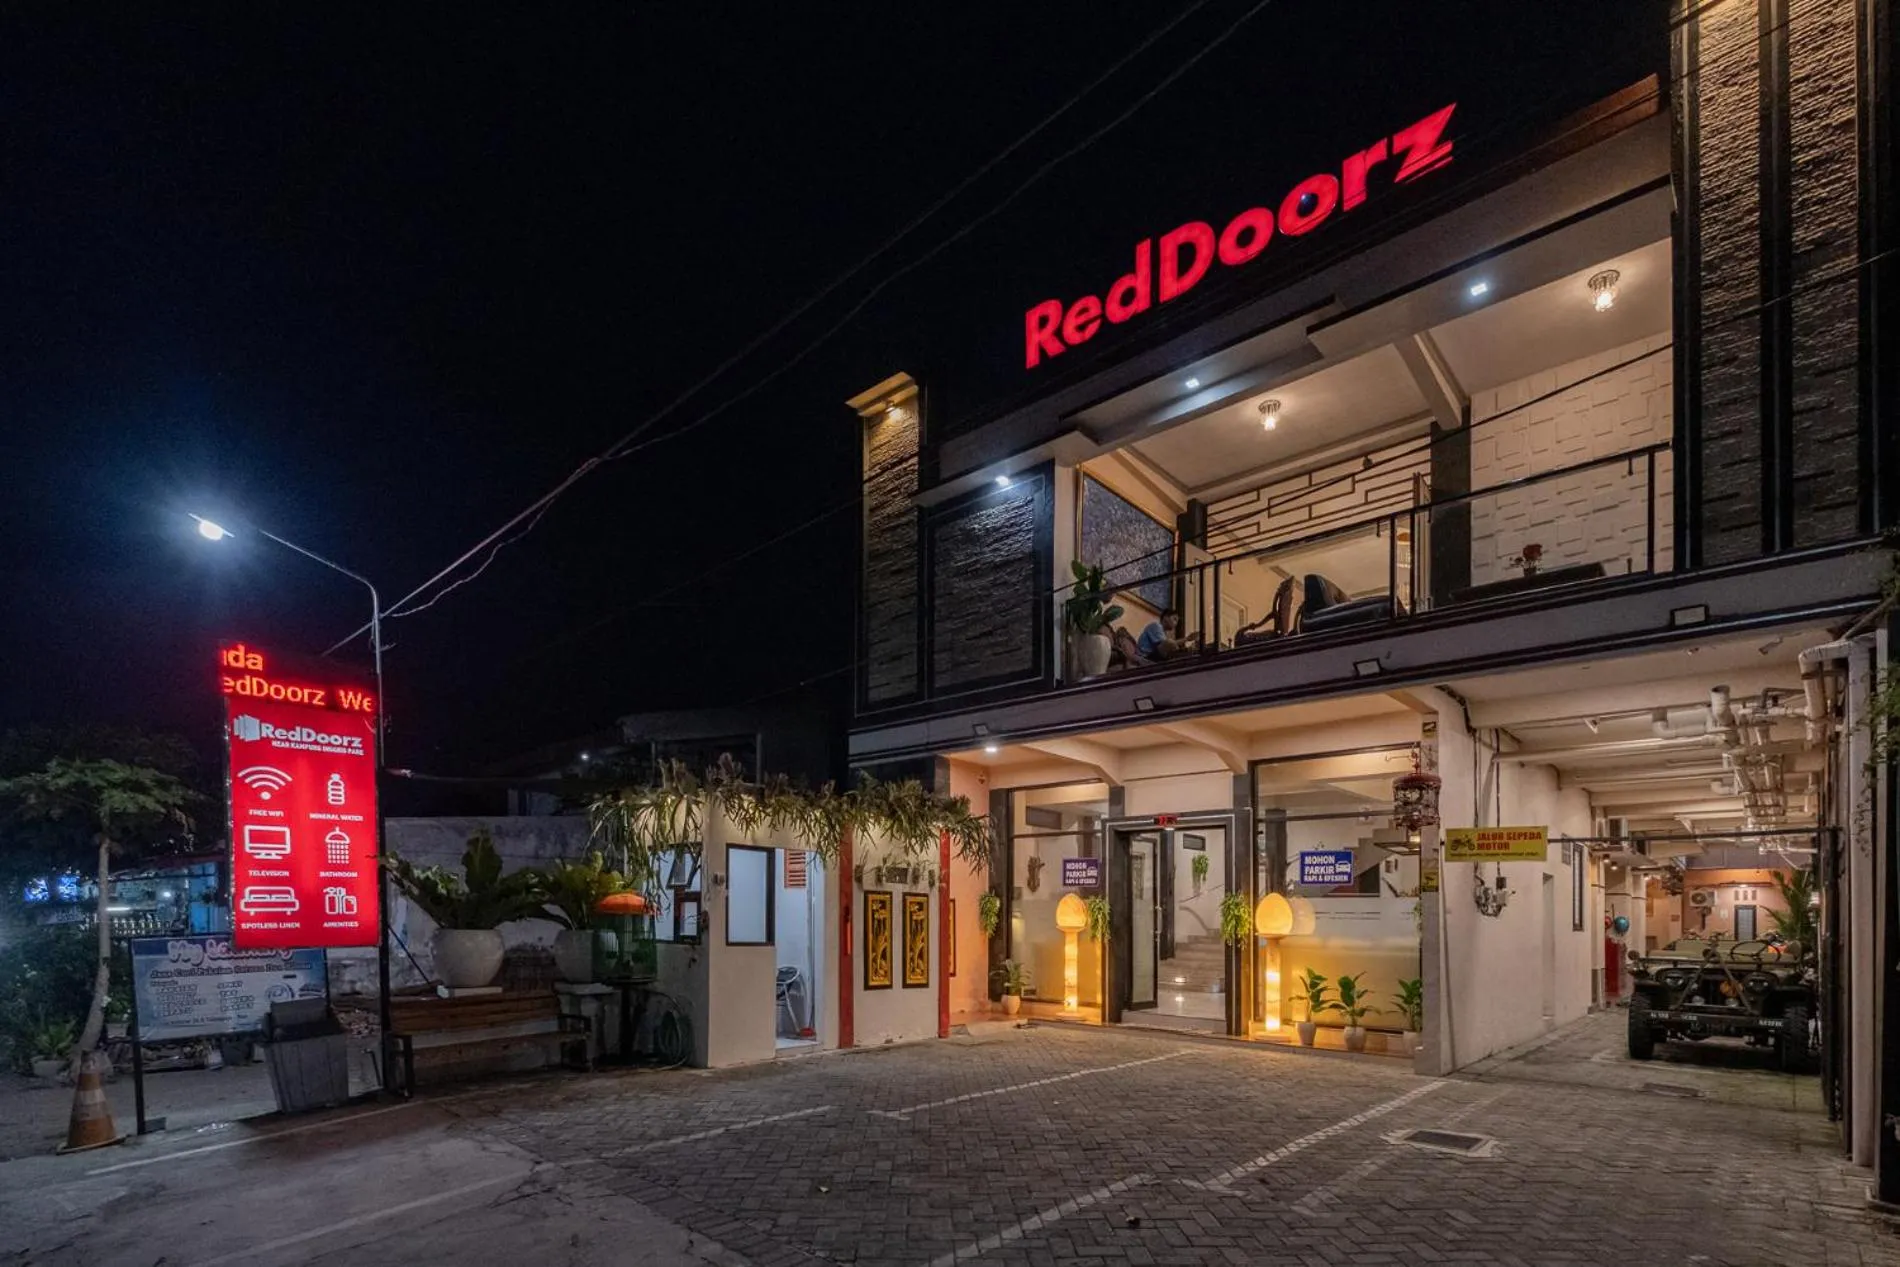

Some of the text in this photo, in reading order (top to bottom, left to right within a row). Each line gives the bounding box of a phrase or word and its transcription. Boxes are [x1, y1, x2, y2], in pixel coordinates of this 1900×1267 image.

[1025, 102, 1457, 369] RedDoorz
[260, 722, 363, 748] RedDoorz
[249, 809, 268, 817] FREE
[309, 812, 340, 821] MINERAL
[1476, 841, 1510, 851] MOTOR
[1305, 855, 1336, 865] MOHON
[248, 870, 290, 878] TELEVISION
[1305, 865, 1335, 875] PARKIR
